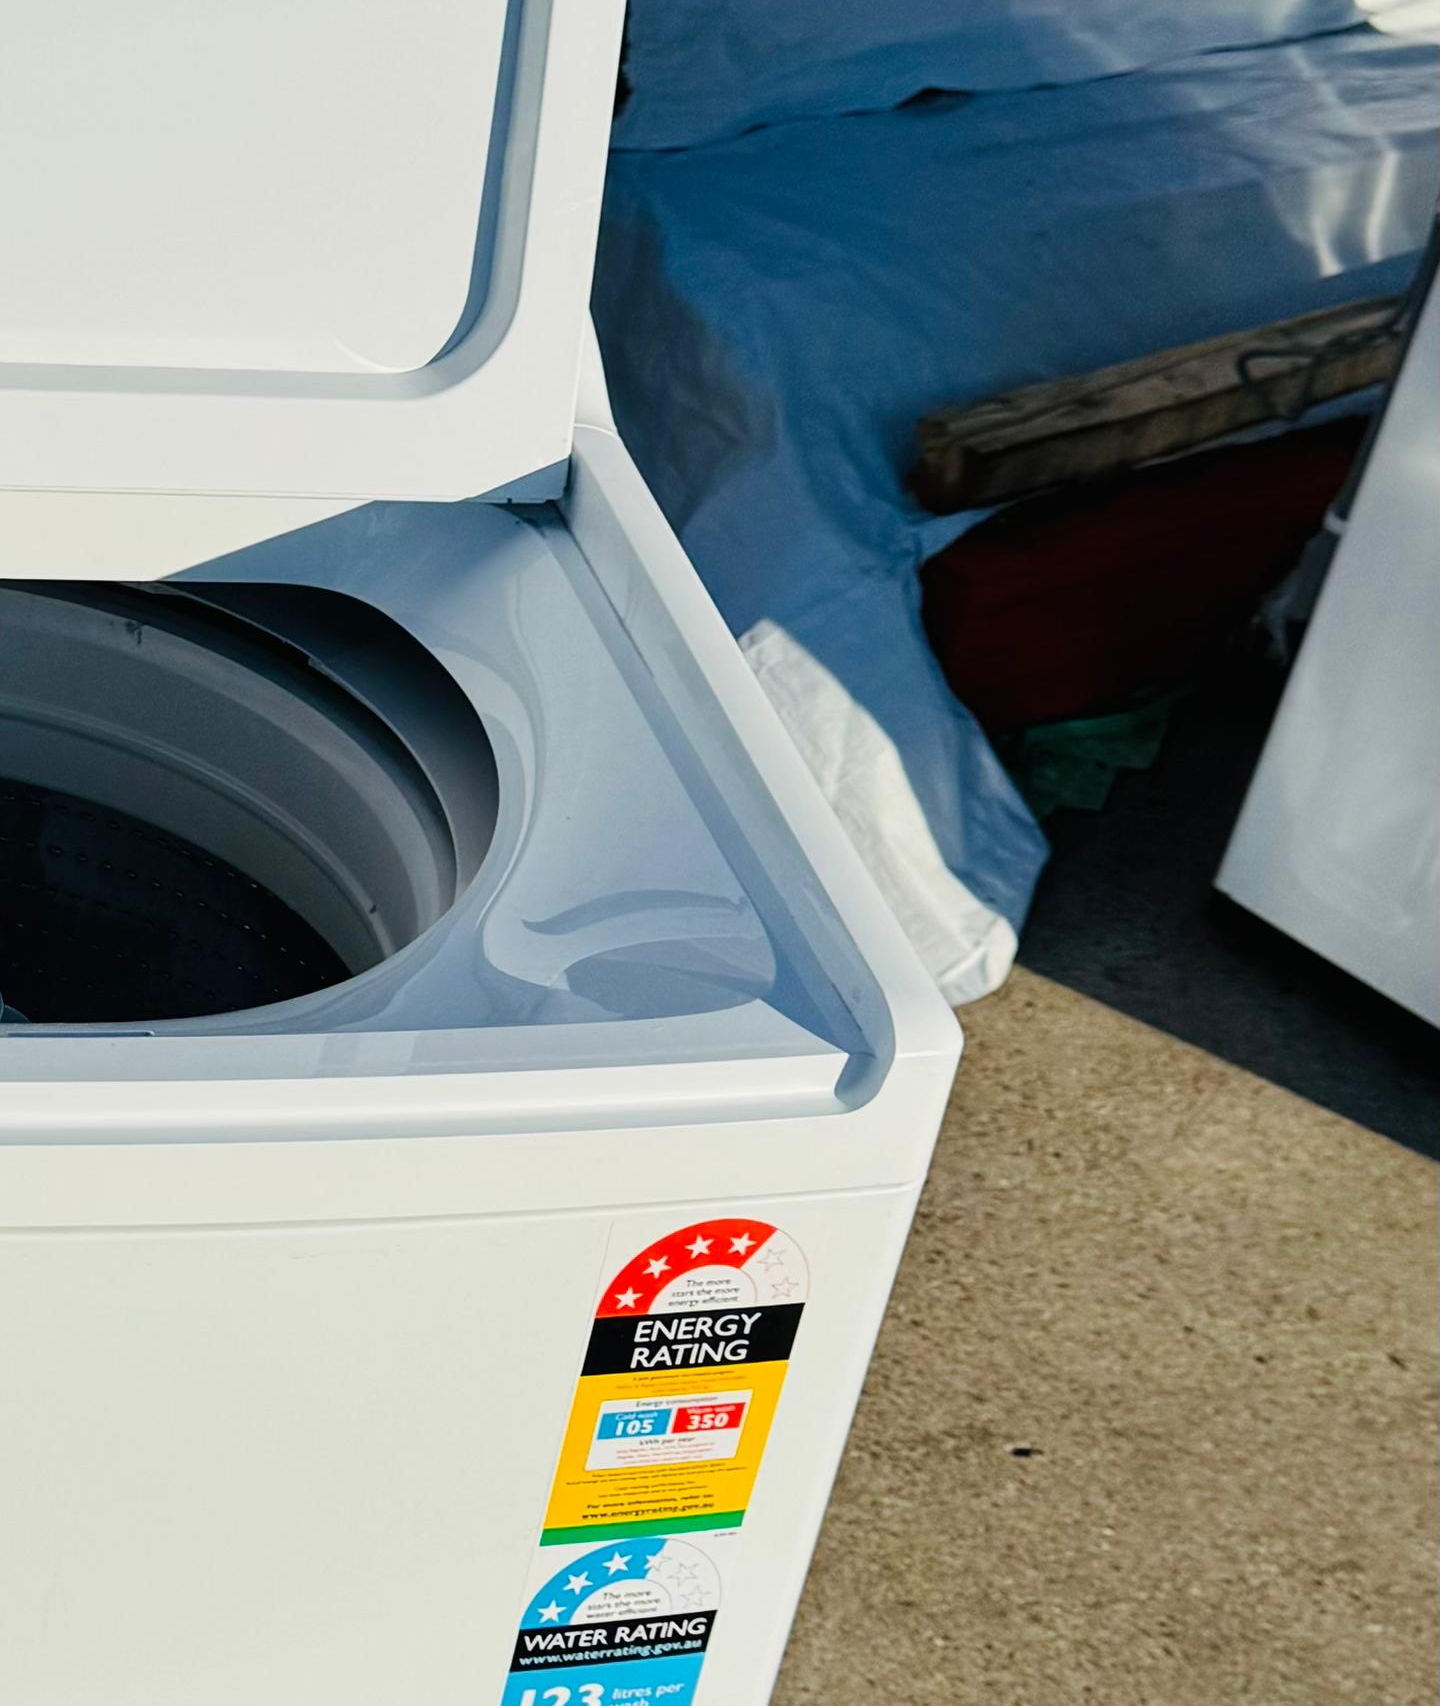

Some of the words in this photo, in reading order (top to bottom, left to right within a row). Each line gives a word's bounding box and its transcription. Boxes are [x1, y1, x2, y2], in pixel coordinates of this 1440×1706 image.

[633, 1312, 762, 1343] ENERGY
[630, 1339, 750, 1369] RATING
[615, 1418, 655, 1436] 105
[686, 1412, 729, 1430] 350
[524, 1629, 607, 1651] WATER
[614, 1617, 708, 1643] RATING
[519, 1640, 702, 1666] www.waterrating.gov.au
[612, 1687, 652, 1700] litres
[656, 1683, 684, 1698] per
